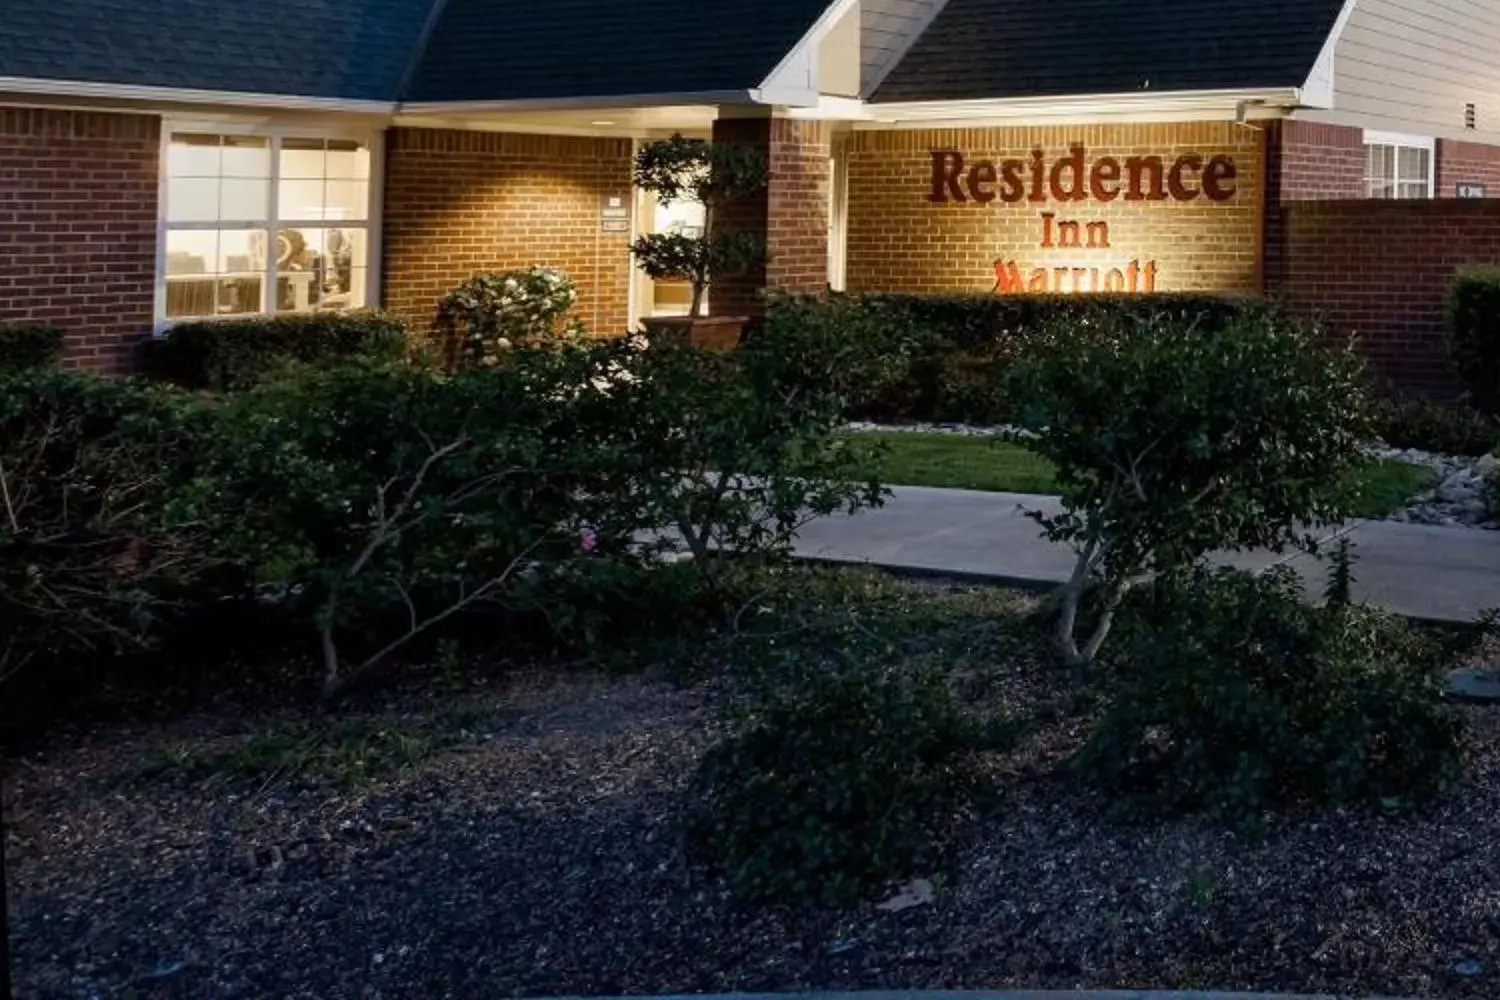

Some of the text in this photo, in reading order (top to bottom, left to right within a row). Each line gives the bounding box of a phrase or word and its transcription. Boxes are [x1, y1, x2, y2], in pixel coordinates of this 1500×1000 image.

[928, 142, 1237, 202] Residence
[1040, 212, 1110, 248] Inn
[991, 257, 1157, 294] Marriott
